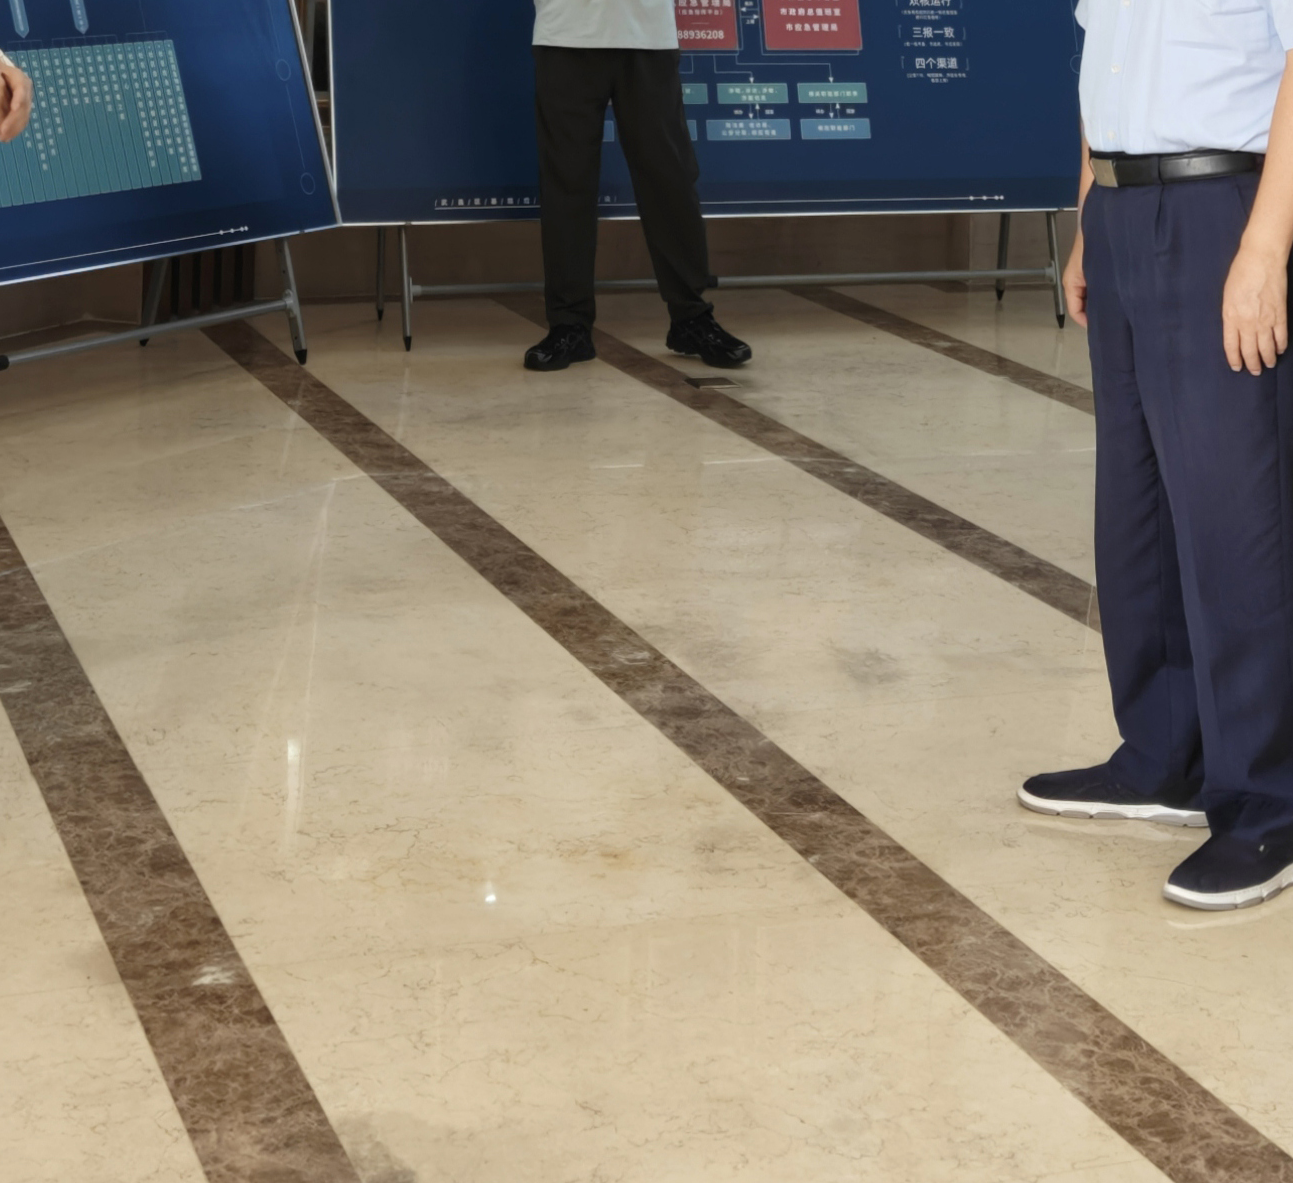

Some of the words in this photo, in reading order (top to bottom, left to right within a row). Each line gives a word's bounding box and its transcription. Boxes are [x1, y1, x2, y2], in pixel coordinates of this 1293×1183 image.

[677, 30, 725, 40] 88936208
[912, 26, 956, 39] 三报一致
[915, 57, 959, 70] 四个渠道
